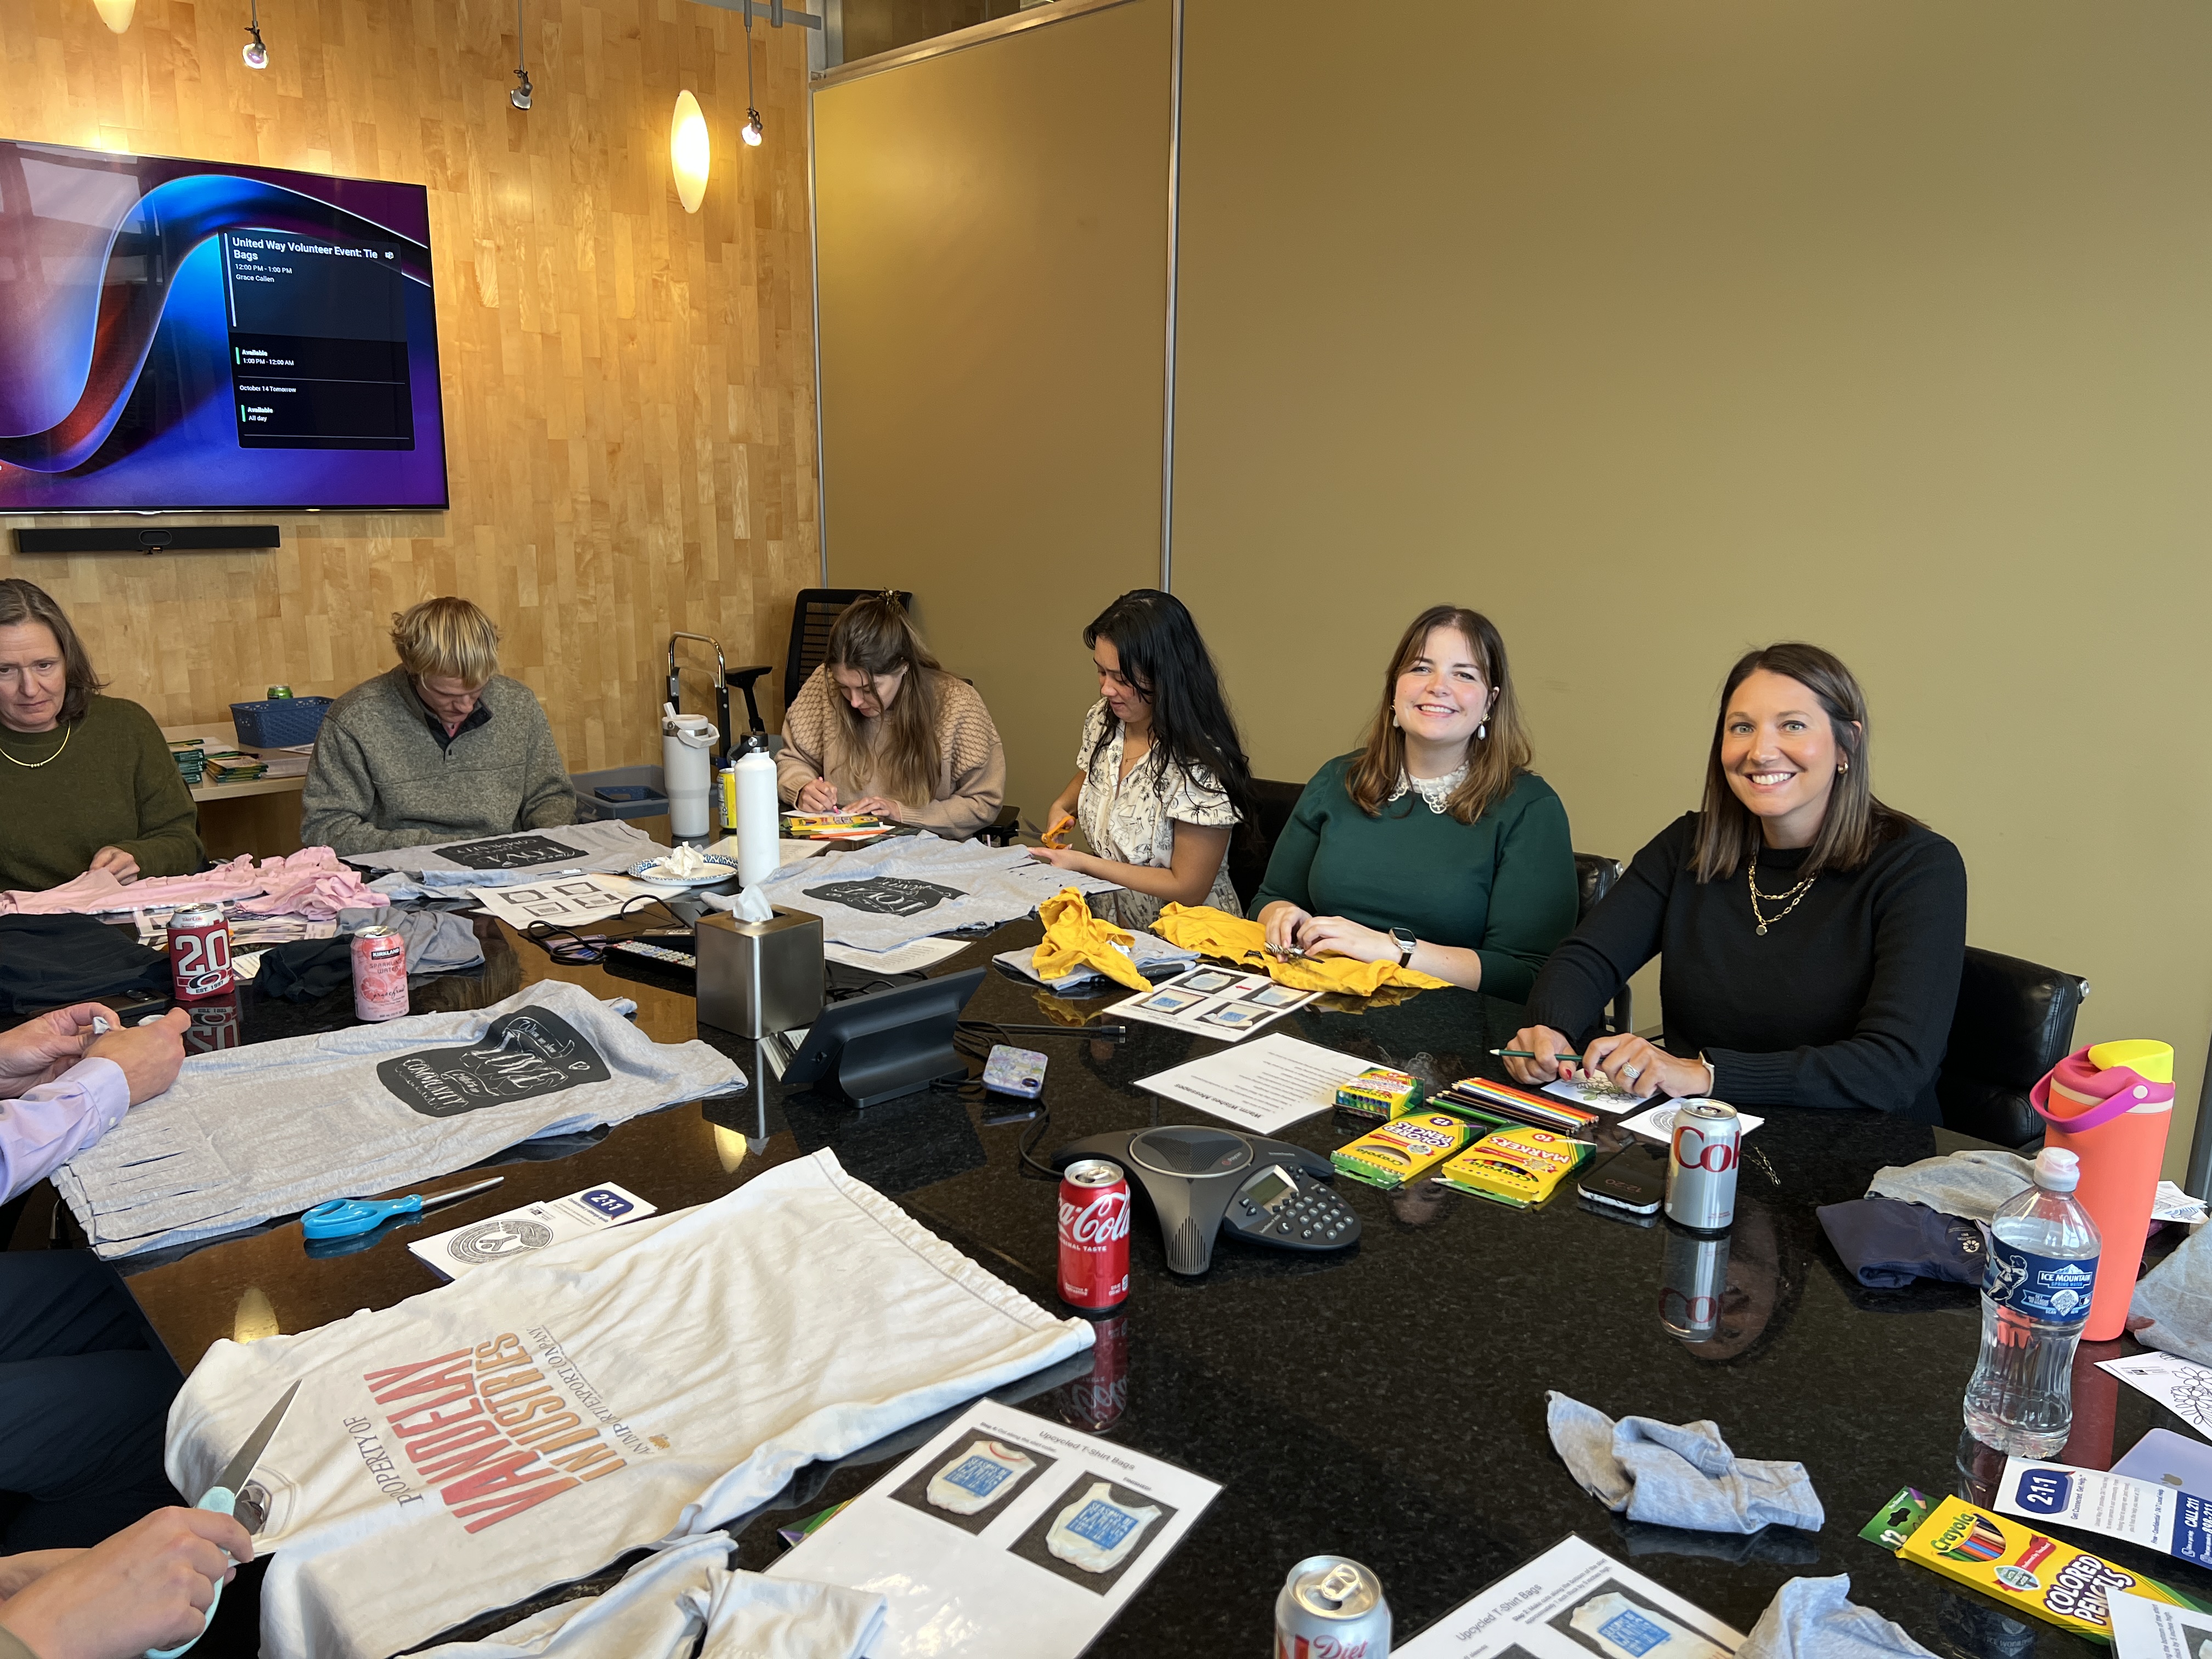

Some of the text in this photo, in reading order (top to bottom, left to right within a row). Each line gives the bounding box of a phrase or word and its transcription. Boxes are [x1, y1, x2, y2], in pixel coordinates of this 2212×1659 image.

[233, 238, 377, 259] United Way Volunteer Event: Tie
[234, 250, 258, 261] Bags
[175, 929, 230, 976] 20
[373, 948, 399, 957] KIRKLAND
[377, 966, 399, 974] WATER
[1383, 1126, 1450, 1148] COLORED
[1398, 1122, 1454, 1143] PENCILS
[1355, 1148, 1404, 1166] Crayola
[1489, 1137, 1570, 1163] MARKERS
[1470, 1161, 1531, 1182] Crayola
[2041, 1273, 2055, 1281] ICE
[363, 1347, 582, 1534] VANDELAY
[1039, 1431, 1136, 1471] Upcycled T-Shirt Bags
[343, 1415, 423, 1507] PROPERTY OF
[2185, 1497, 2200, 1528] CALL 211
[1879, 1529, 1908, 1546] 12
[1930, 1513, 1975, 1552] Crayola
[2046, 1556, 2102, 1613] COLORED
[1455, 1583, 1543, 1642] Upcycled T-Shirt Bags
[1313, 1634, 1369, 1659] Diet
